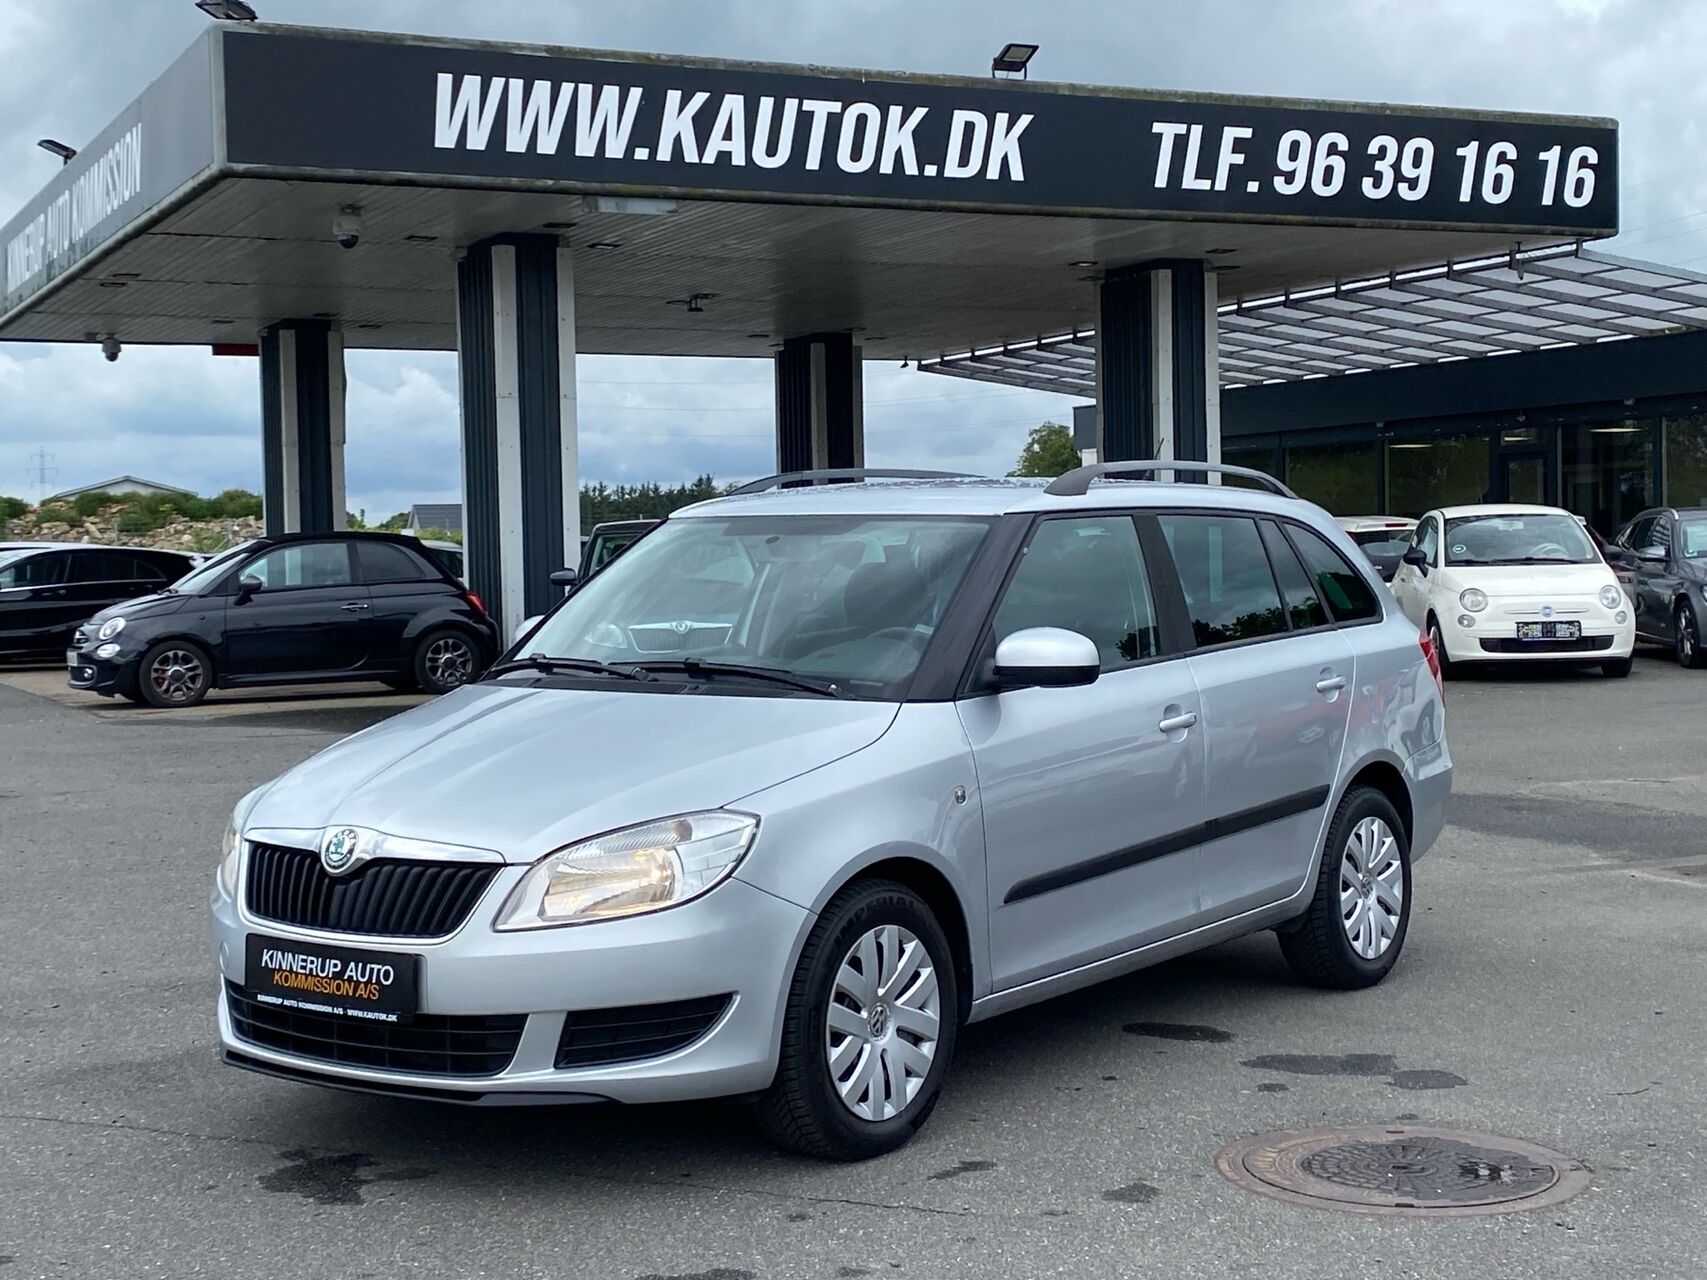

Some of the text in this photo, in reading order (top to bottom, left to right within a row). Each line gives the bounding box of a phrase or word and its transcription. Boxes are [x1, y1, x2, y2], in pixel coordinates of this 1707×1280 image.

[434, 73, 1034, 181] WWW.KAUTOK.DK
[1152, 121, 1599, 208] TLF. 96 39 16 16
[72, 123, 142, 243] KOMMISSION
[261, 949, 394, 985] KINNERUP AUTO
[273, 971, 380, 1000] KOMMISSION A/S
